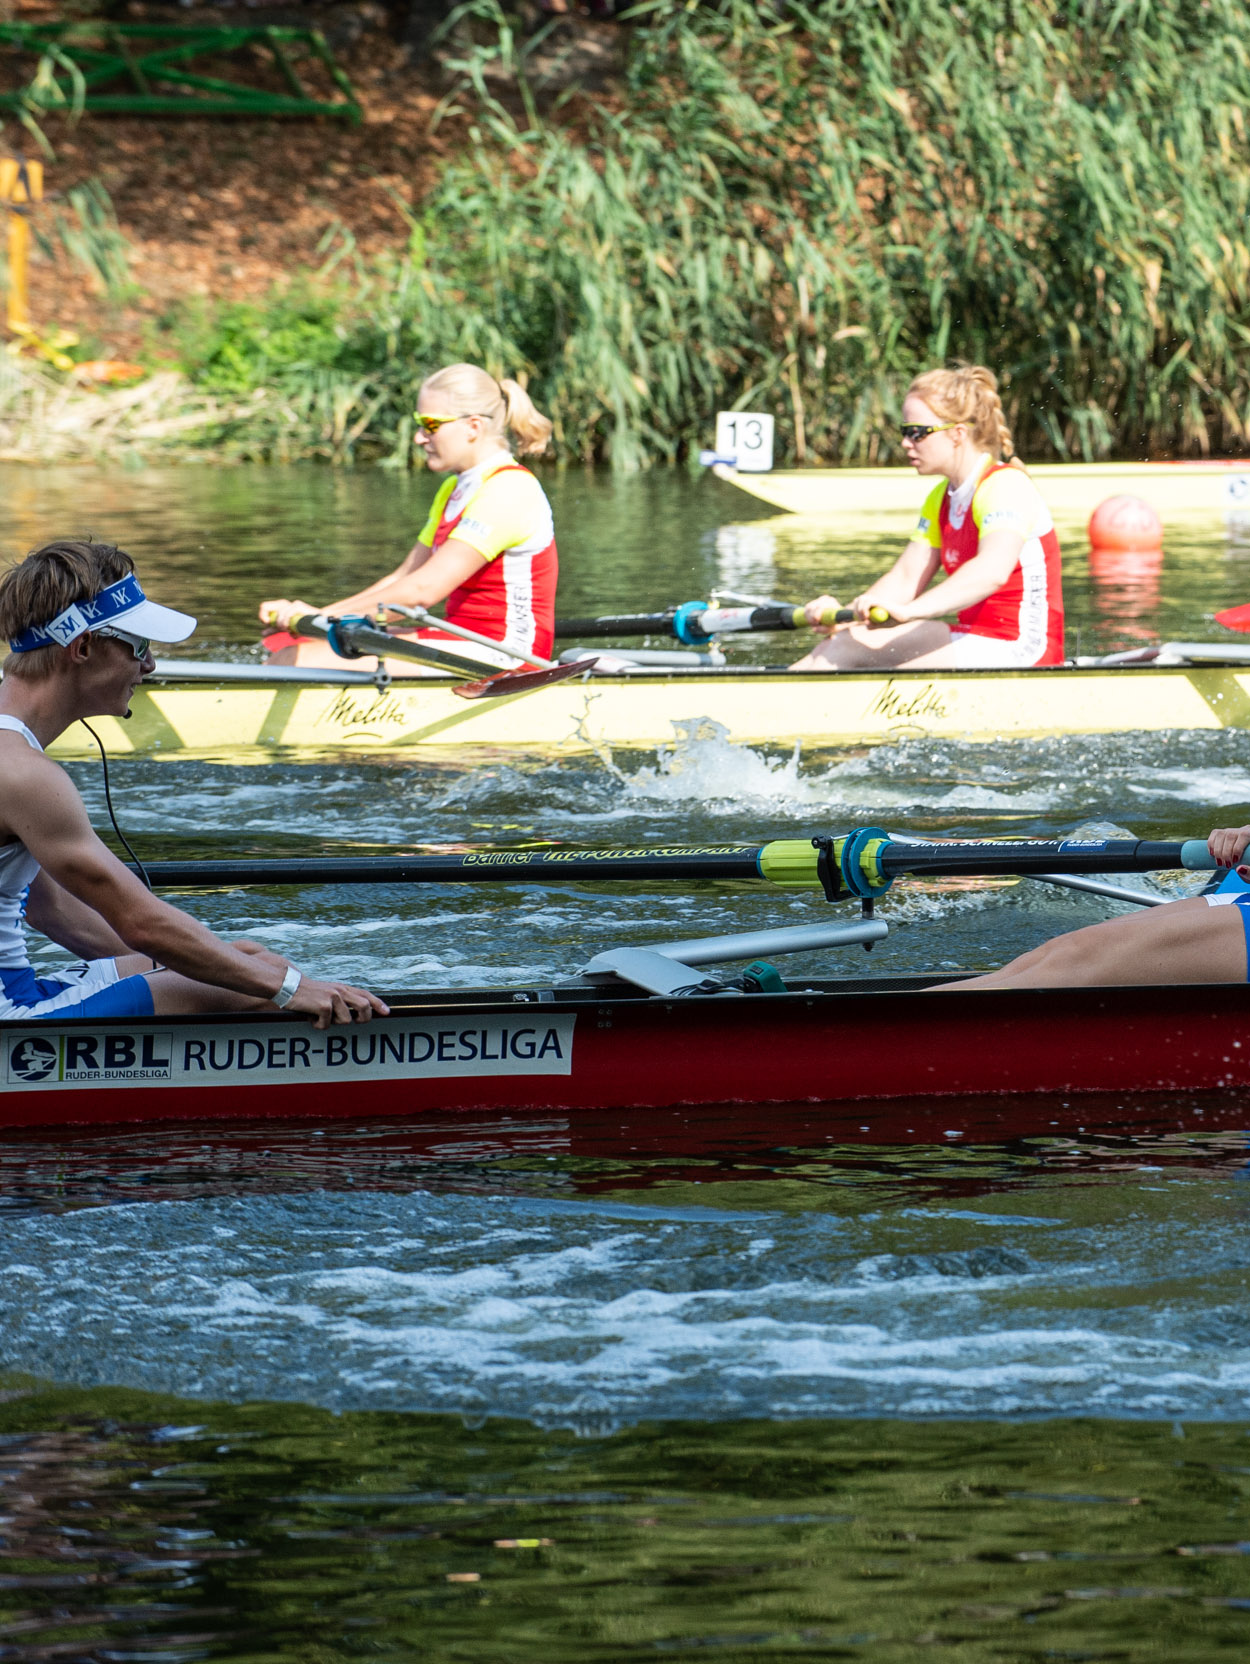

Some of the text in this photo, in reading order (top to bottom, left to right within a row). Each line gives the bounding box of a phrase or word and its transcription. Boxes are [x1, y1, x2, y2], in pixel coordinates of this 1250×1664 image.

[727, 420, 763, 450] 13
[78, 600, 104, 620] NK
[110, 587, 132, 609] NK
[313, 685, 408, 727] Melitta
[861, 677, 950, 719] Melitta
[66, 1028, 563, 1071] RBL RUDER-BUNDESLIGA
[65, 1070, 169, 1080] RUDER-BUNDESLIGA
